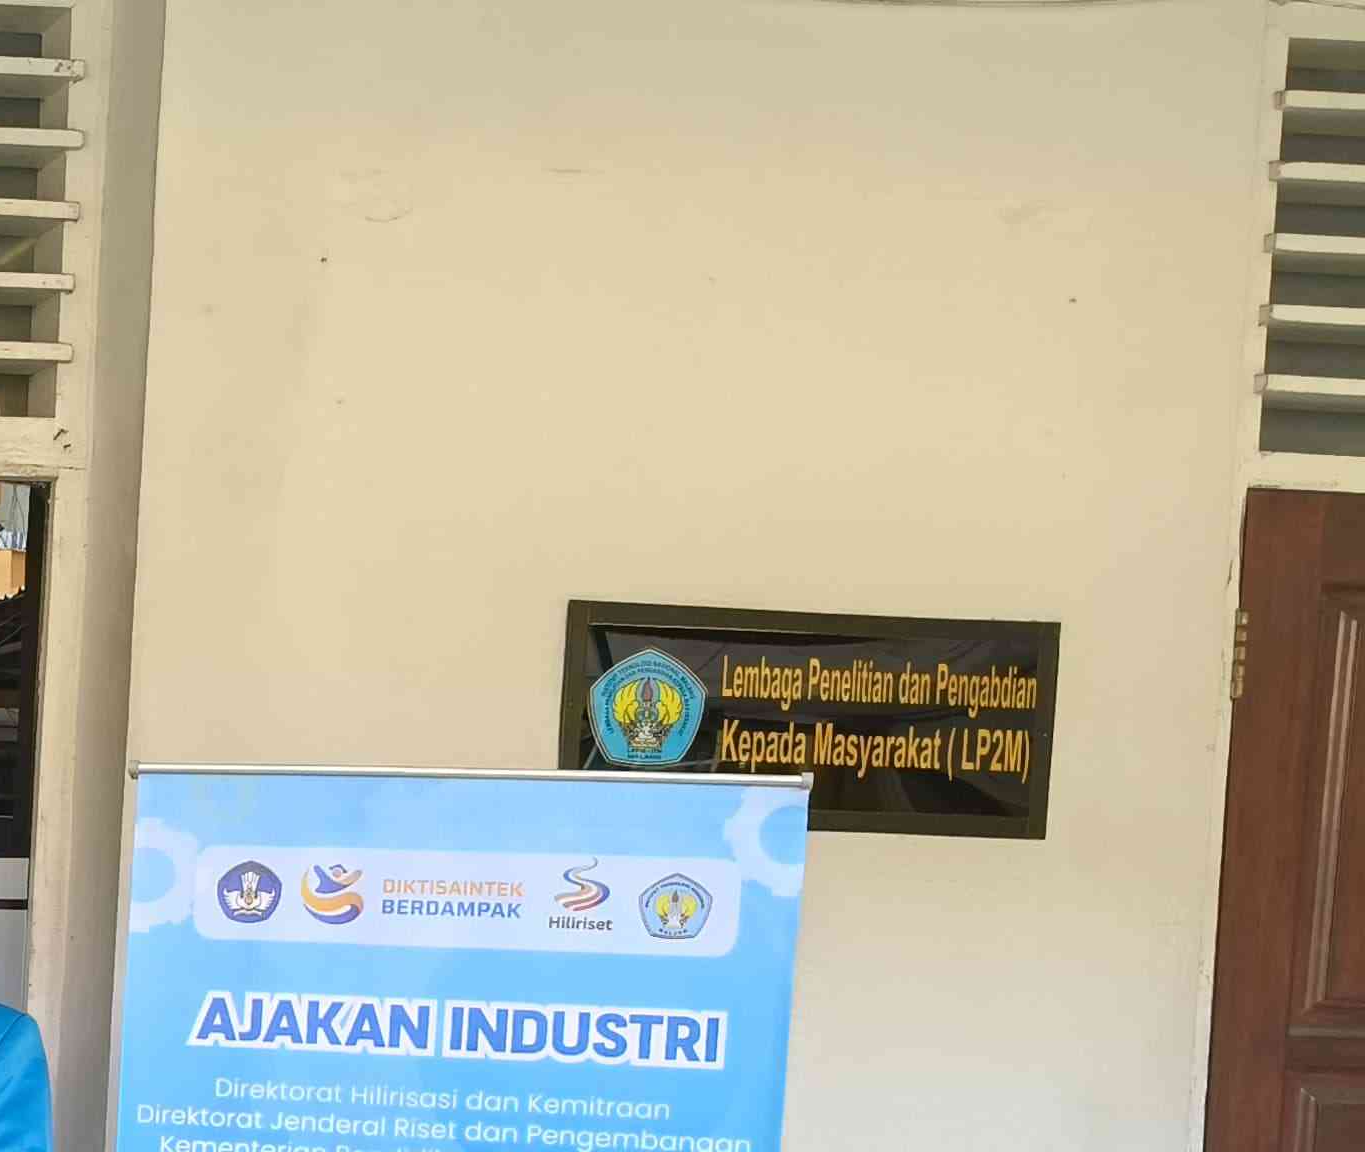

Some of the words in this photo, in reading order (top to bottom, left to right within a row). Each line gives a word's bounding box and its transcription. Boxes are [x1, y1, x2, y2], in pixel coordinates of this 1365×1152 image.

[722, 655, 802, 710] Lembaga
[808, 658, 893, 705] Penelitian
[899, 662, 930, 704] dan
[936, 664, 1037, 718] Pengabdian
[721, 719, 805, 772] Kepada
[813, 723, 941, 778] Masyarakat
[382, 878, 524, 898] DIKTISAINTEK
[381, 898, 522, 919] BERDAMPAK
[548, 915, 612, 931] Hiliriset
[193, 995, 432, 1052] AJAKAN
[447, 1004, 723, 1065] INDUSTRI
[215, 1078, 343, 1104] Direktorat
[351, 1085, 457, 1109] Hilirisasi
[466, 1090, 519, 1112] dan
[528, 1094, 670, 1119] Kemitraan
[136, 1104, 262, 1130] Direktorat
[270, 1111, 386, 1136] Jenderal
[394, 1117, 456, 1140] Riset
[464, 1122, 518, 1143] dan
